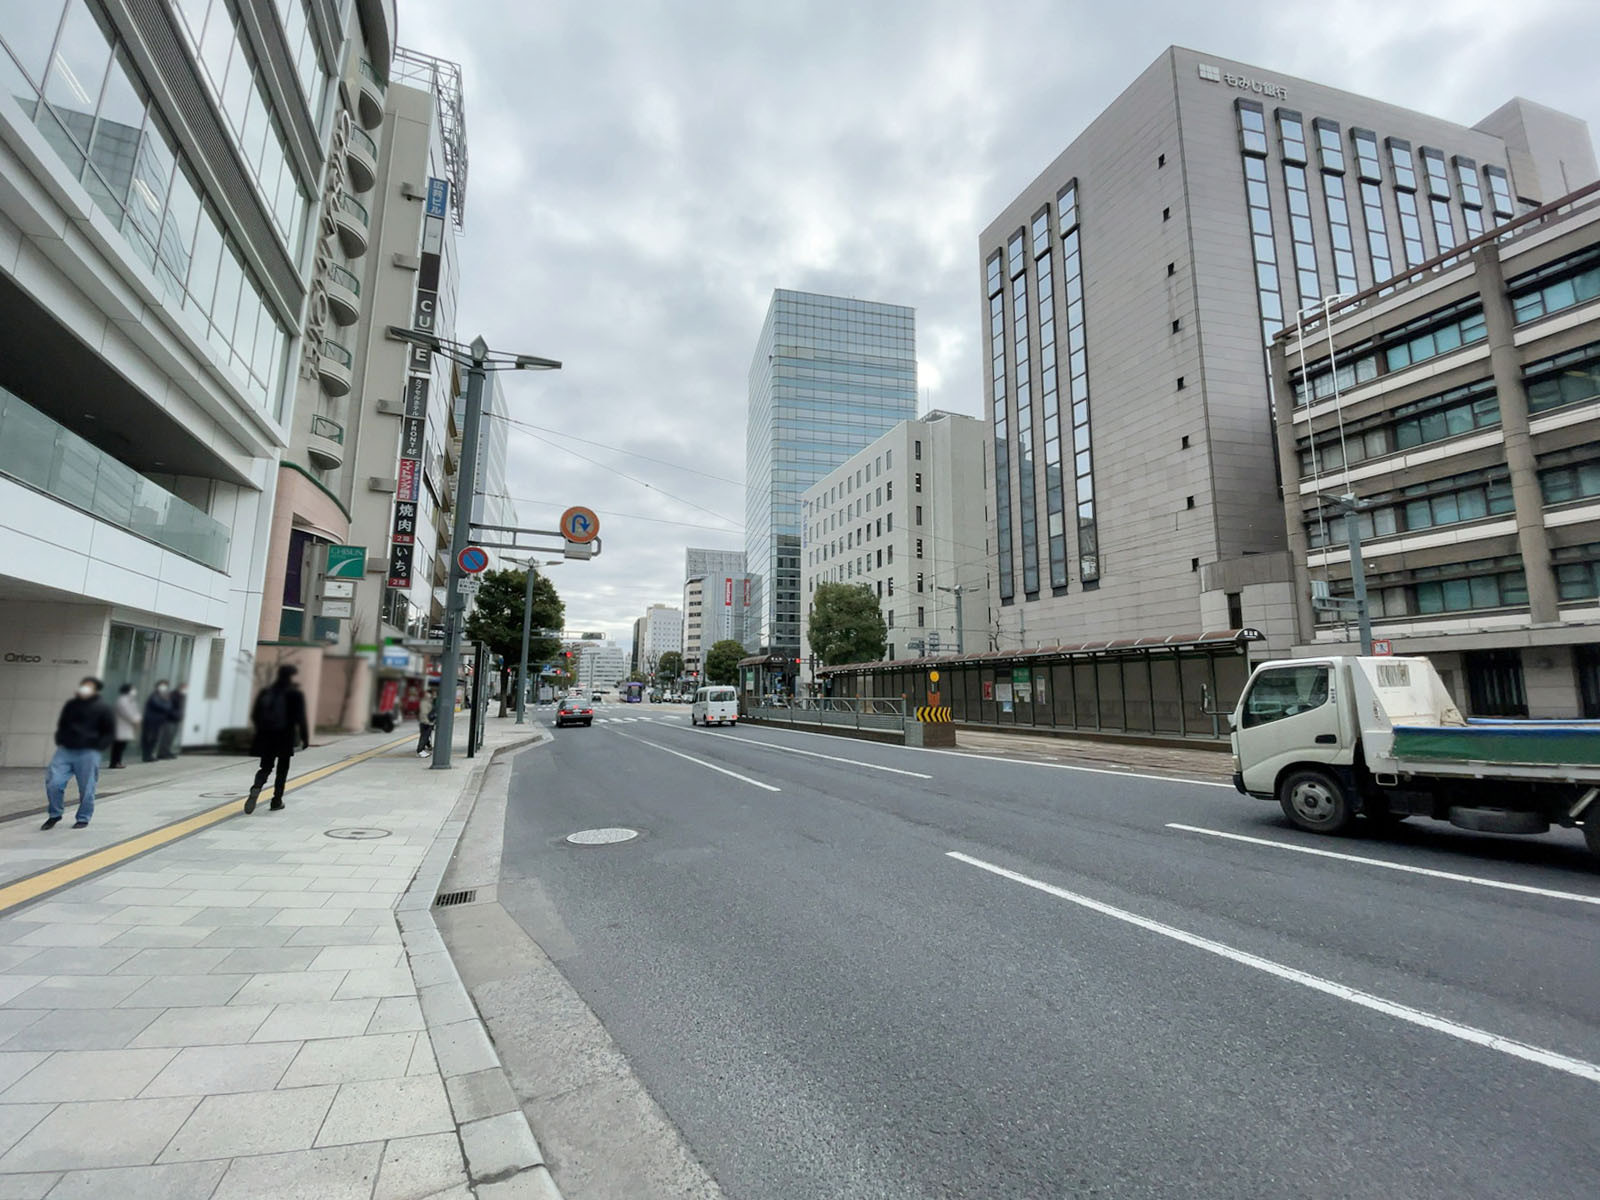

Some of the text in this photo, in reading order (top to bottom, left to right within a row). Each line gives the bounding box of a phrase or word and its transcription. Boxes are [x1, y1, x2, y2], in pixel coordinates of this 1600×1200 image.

[1223, 72, 1288, 101] もみじ銀行
[398, 503, 414, 533] 焼肉
[4, 651, 41, 663] Orico
